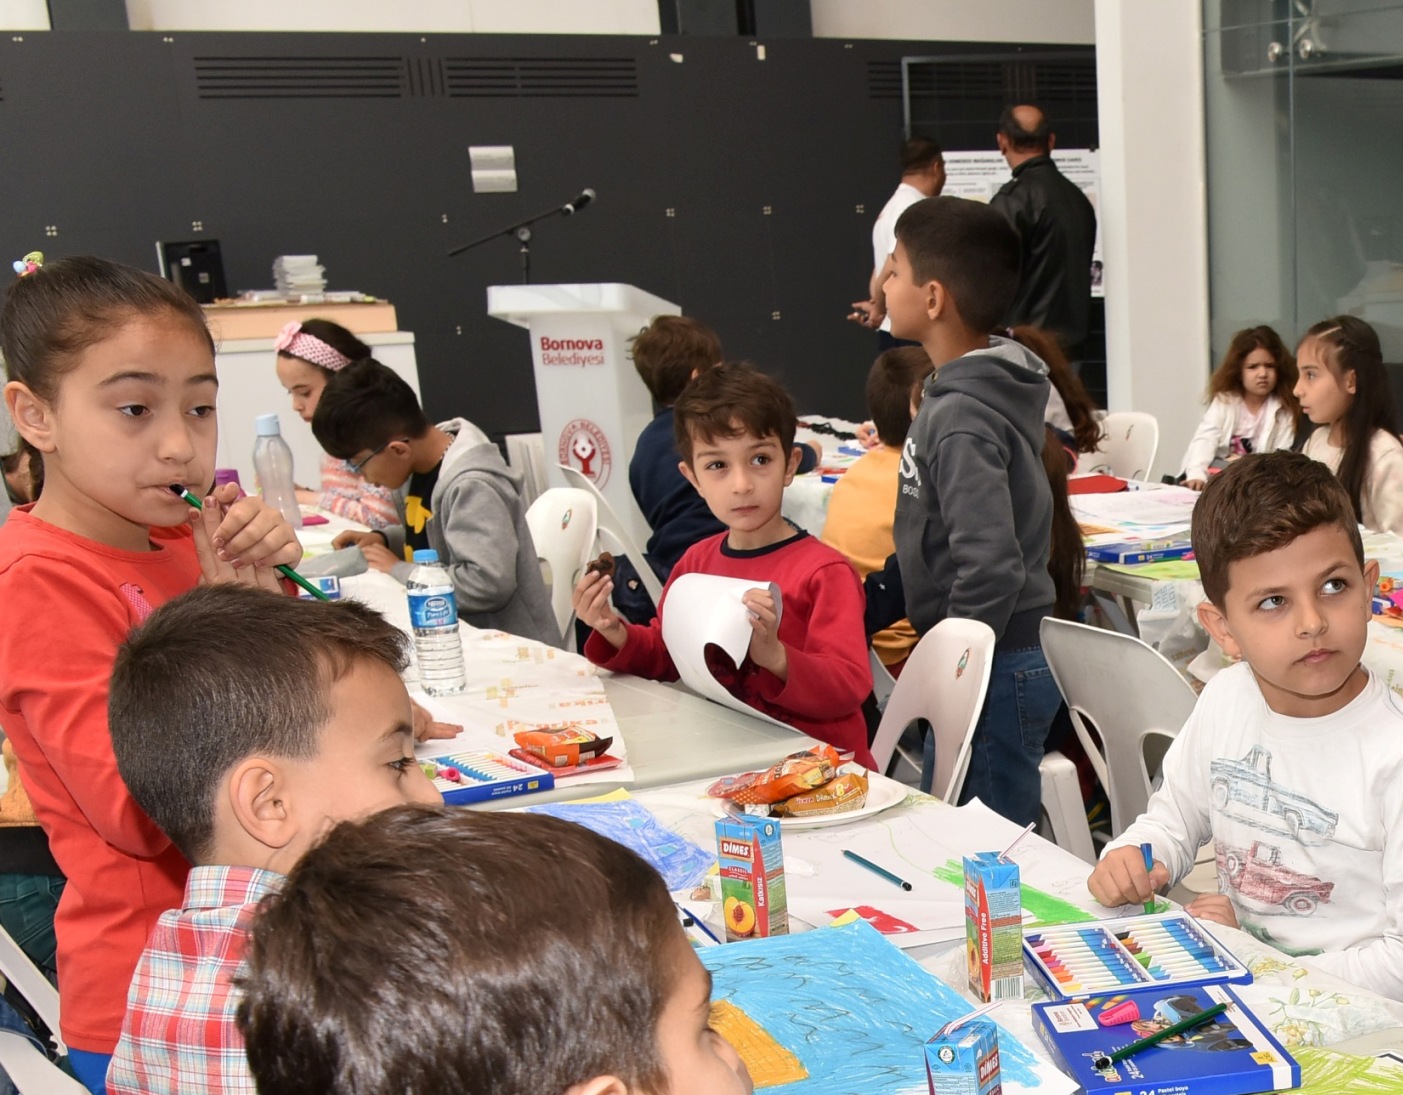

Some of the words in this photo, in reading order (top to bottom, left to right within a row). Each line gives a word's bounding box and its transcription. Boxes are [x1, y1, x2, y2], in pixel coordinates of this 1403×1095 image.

[541, 337, 603, 351] Bornova
[542, 353, 604, 367] Belediyesi
[981, 932, 989, 965] Additive
